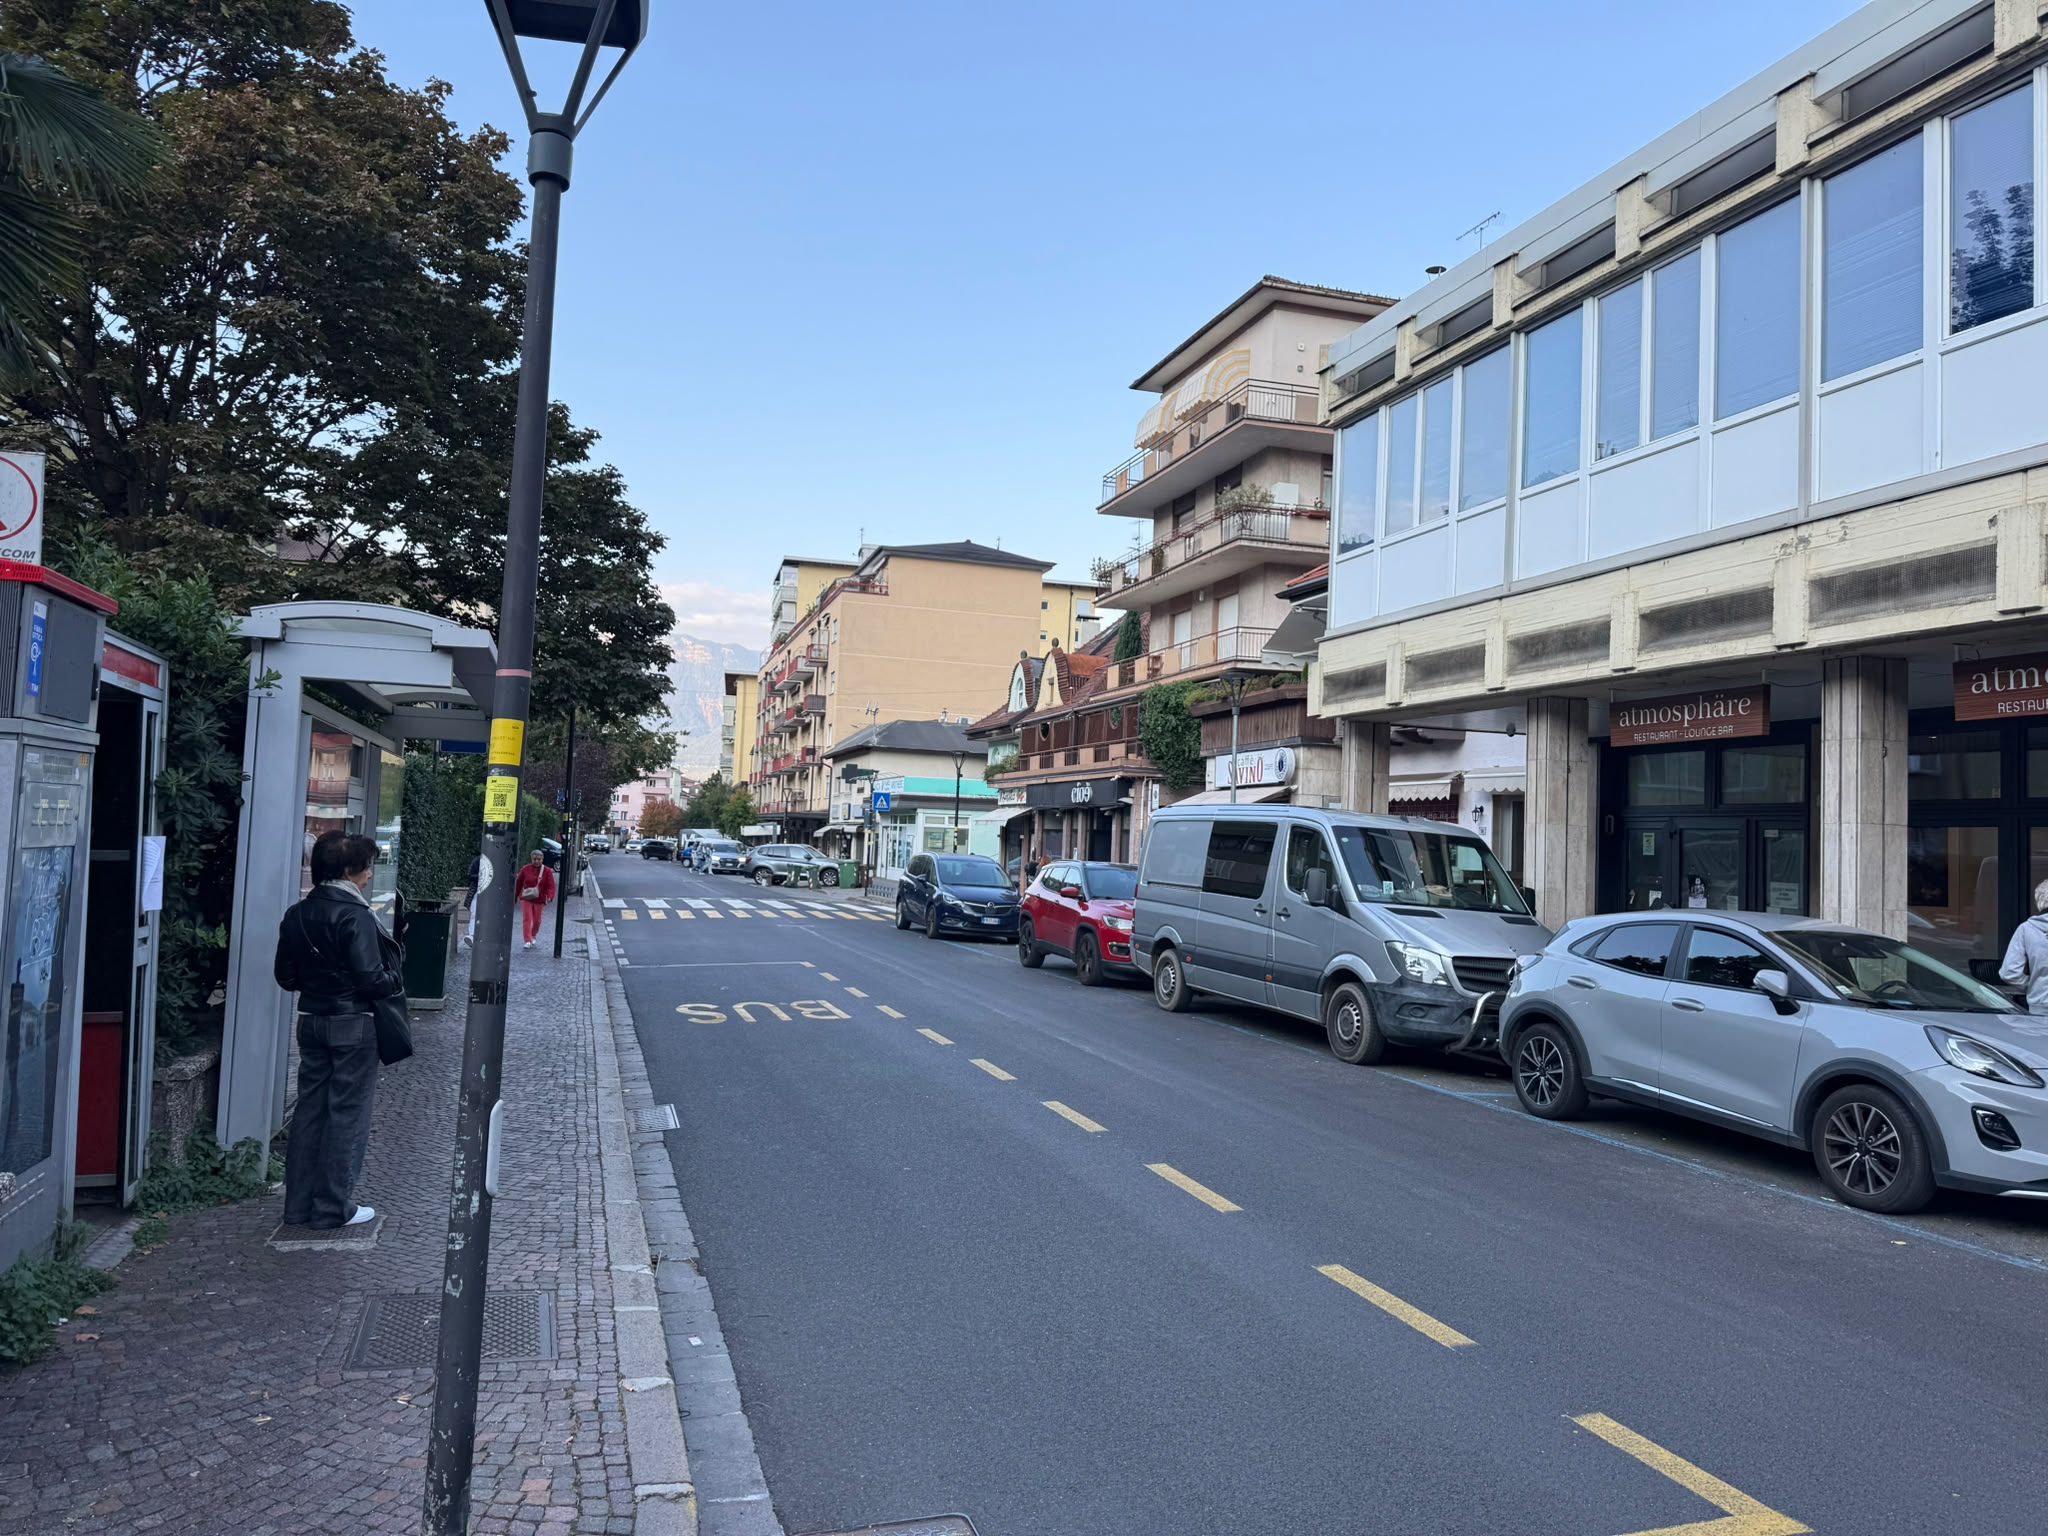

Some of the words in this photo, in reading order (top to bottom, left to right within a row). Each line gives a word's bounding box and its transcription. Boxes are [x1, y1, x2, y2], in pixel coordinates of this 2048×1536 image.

[0, 548, 36, 559] COM
[1971, 667, 2048, 694] atm
[1619, 694, 1751, 727] atmosphäre
[1998, 699, 2048, 713] RESTAU
[1634, 730, 1678, 742] RESTAURANT
[1684, 726, 1717, 738] LOUNGE
[1717, 725, 1734, 736] BAR
[676, 1000, 852, 1024] BUS
